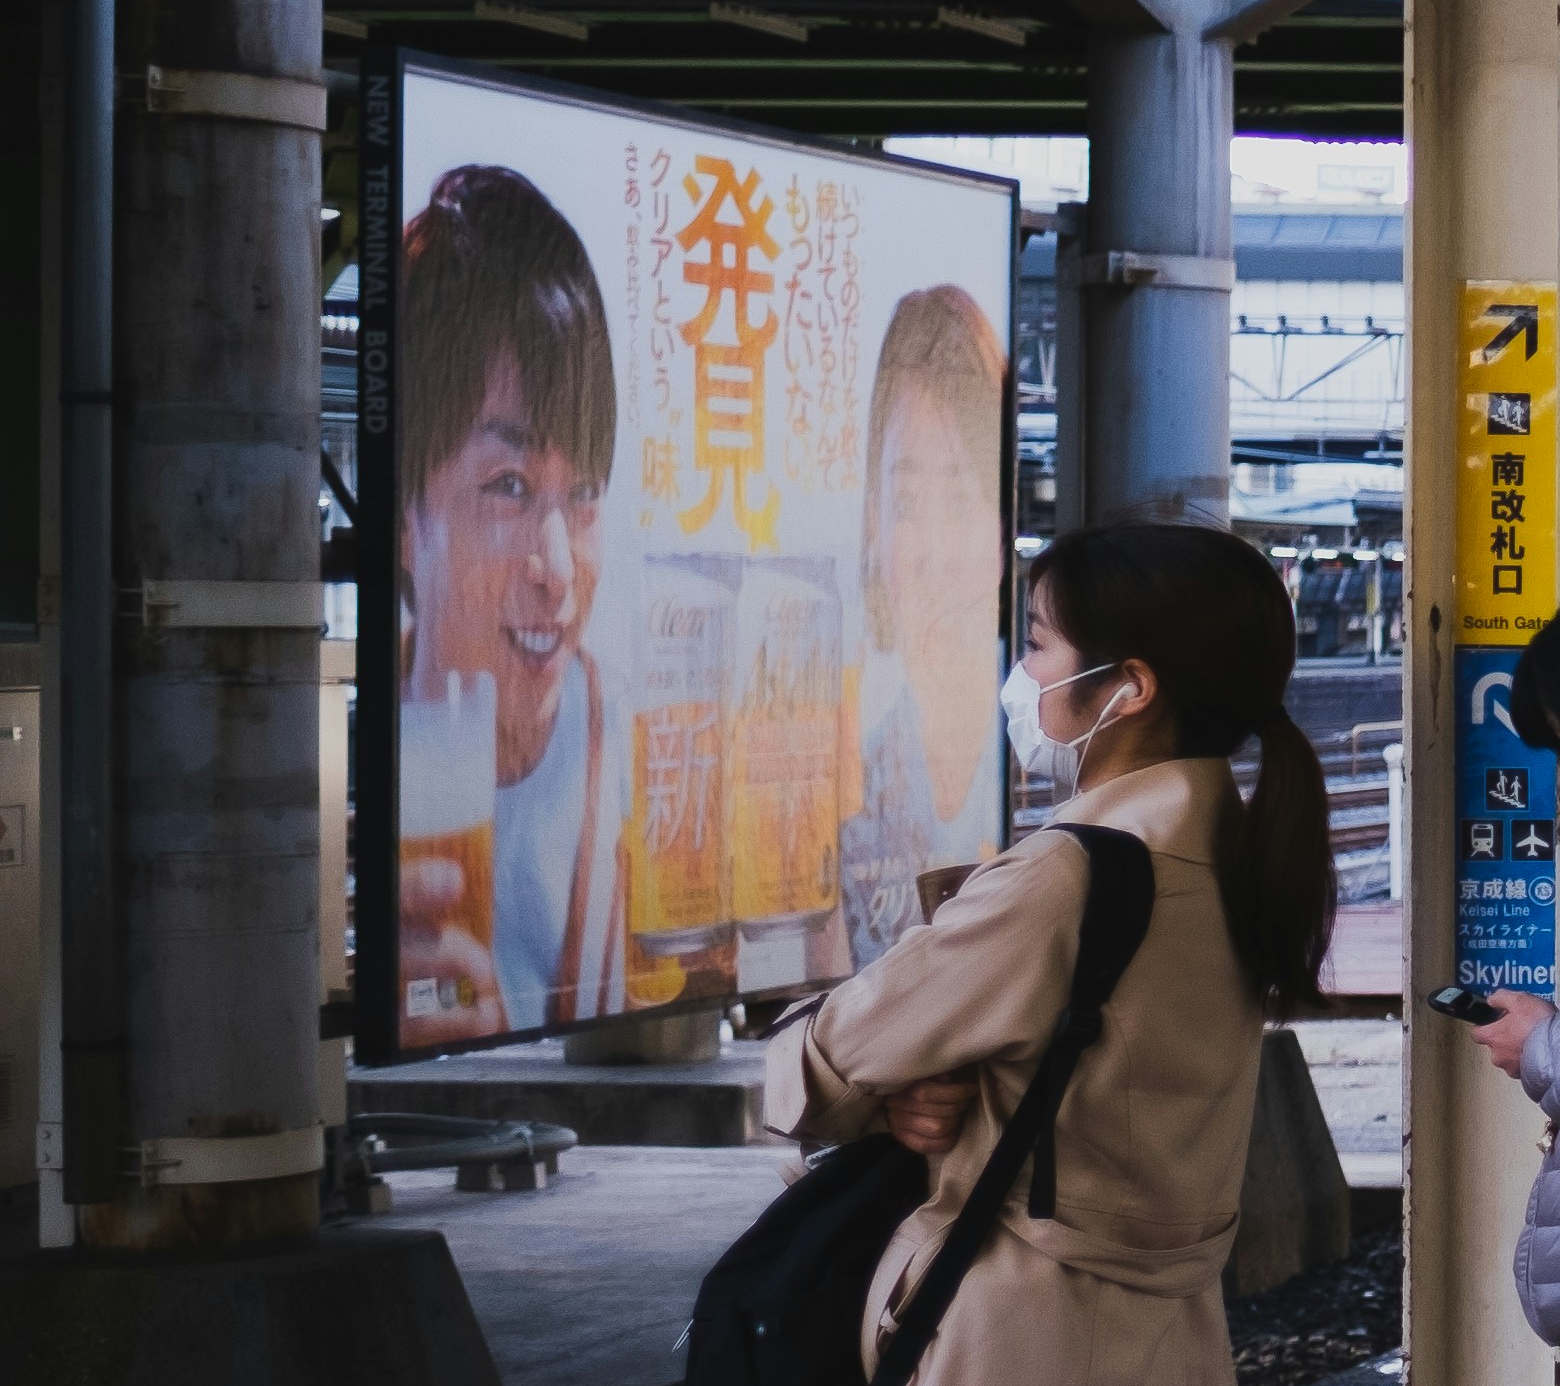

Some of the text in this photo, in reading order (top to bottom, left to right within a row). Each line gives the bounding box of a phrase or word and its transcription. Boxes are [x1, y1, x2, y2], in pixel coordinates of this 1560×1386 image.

[364, 75, 389, 435] NEW TERMINAL BOARD
[676, 153, 783, 535] 発見
[1490, 452, 1526, 596] 南改札口
[1463, 616, 1509, 629] South
[1459, 878, 1528, 900] 京成線
[1459, 904, 1530, 916] Keisei Line
[1459, 924, 1552, 936] スカイライナー
